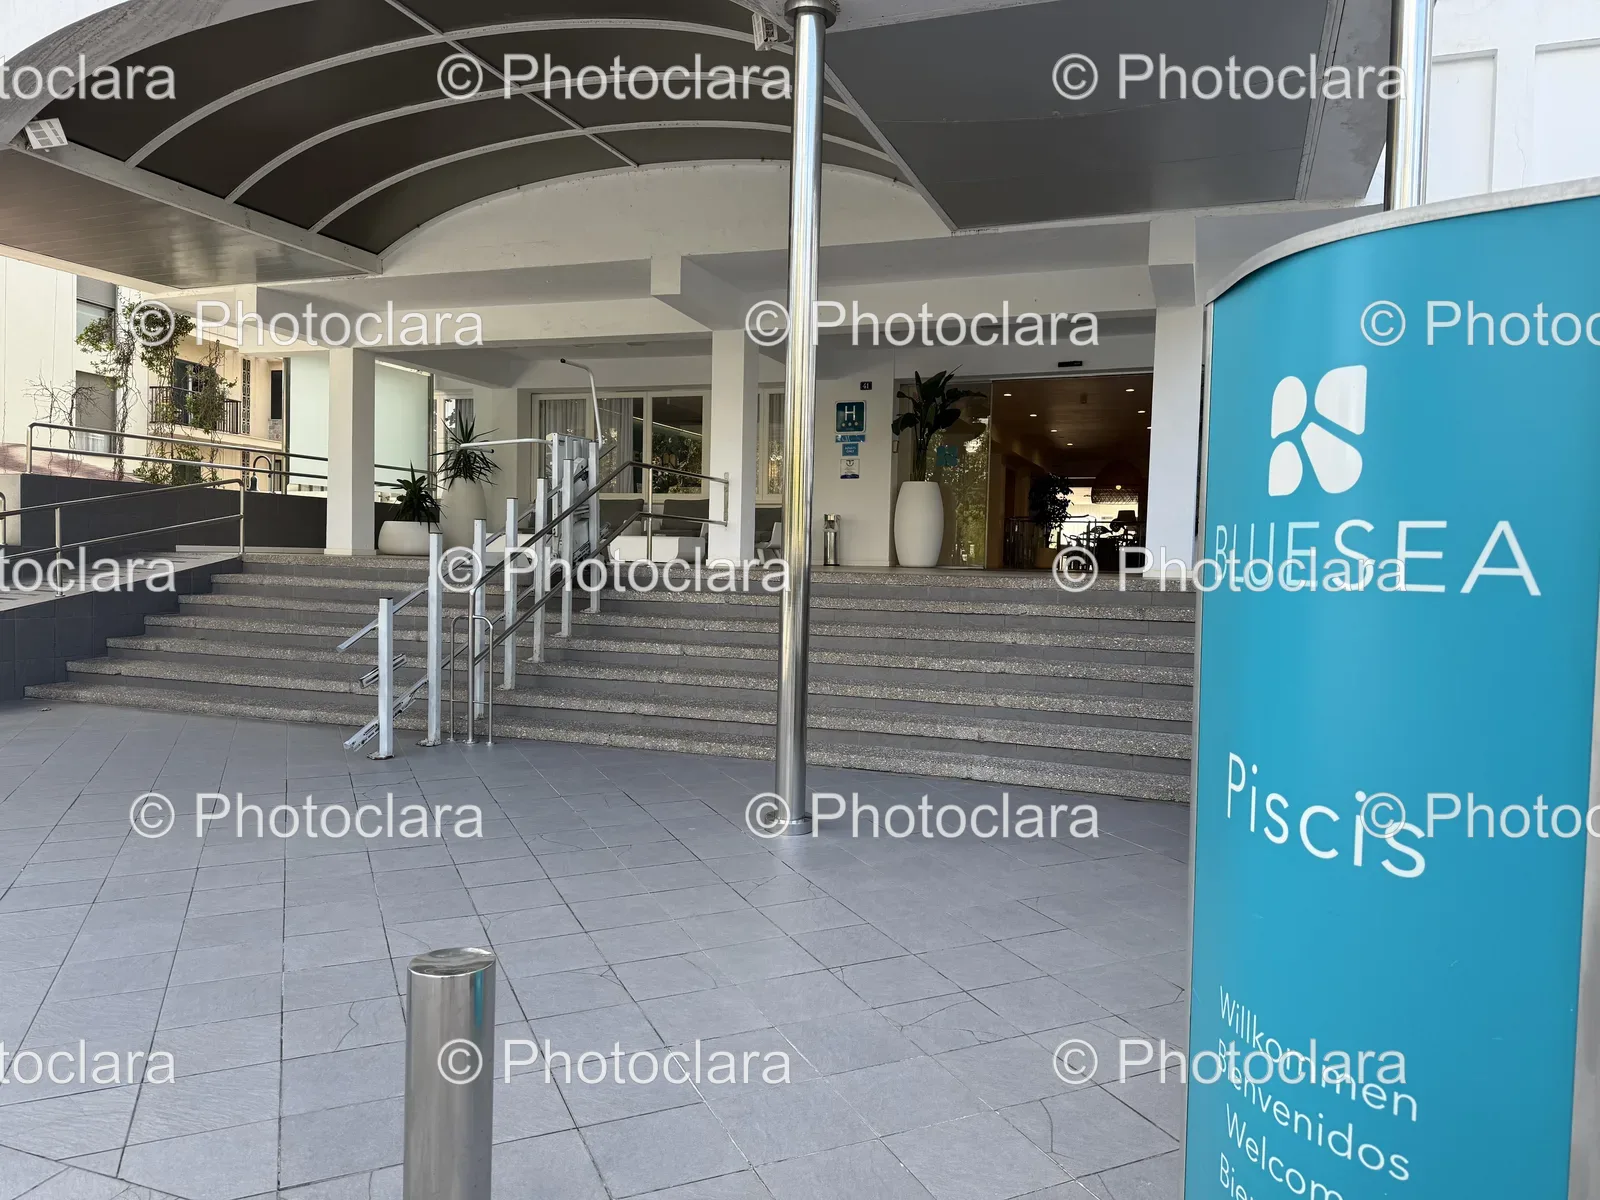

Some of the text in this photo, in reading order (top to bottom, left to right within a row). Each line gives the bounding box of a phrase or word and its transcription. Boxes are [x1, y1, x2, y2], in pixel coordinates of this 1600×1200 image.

[844, 405, 856, 421] H
[1227, 751, 1426, 878] Piscis
[1217, 1038, 1410, 1181] Bienvenidos
[1219, 985, 1418, 1122] Willkommen
